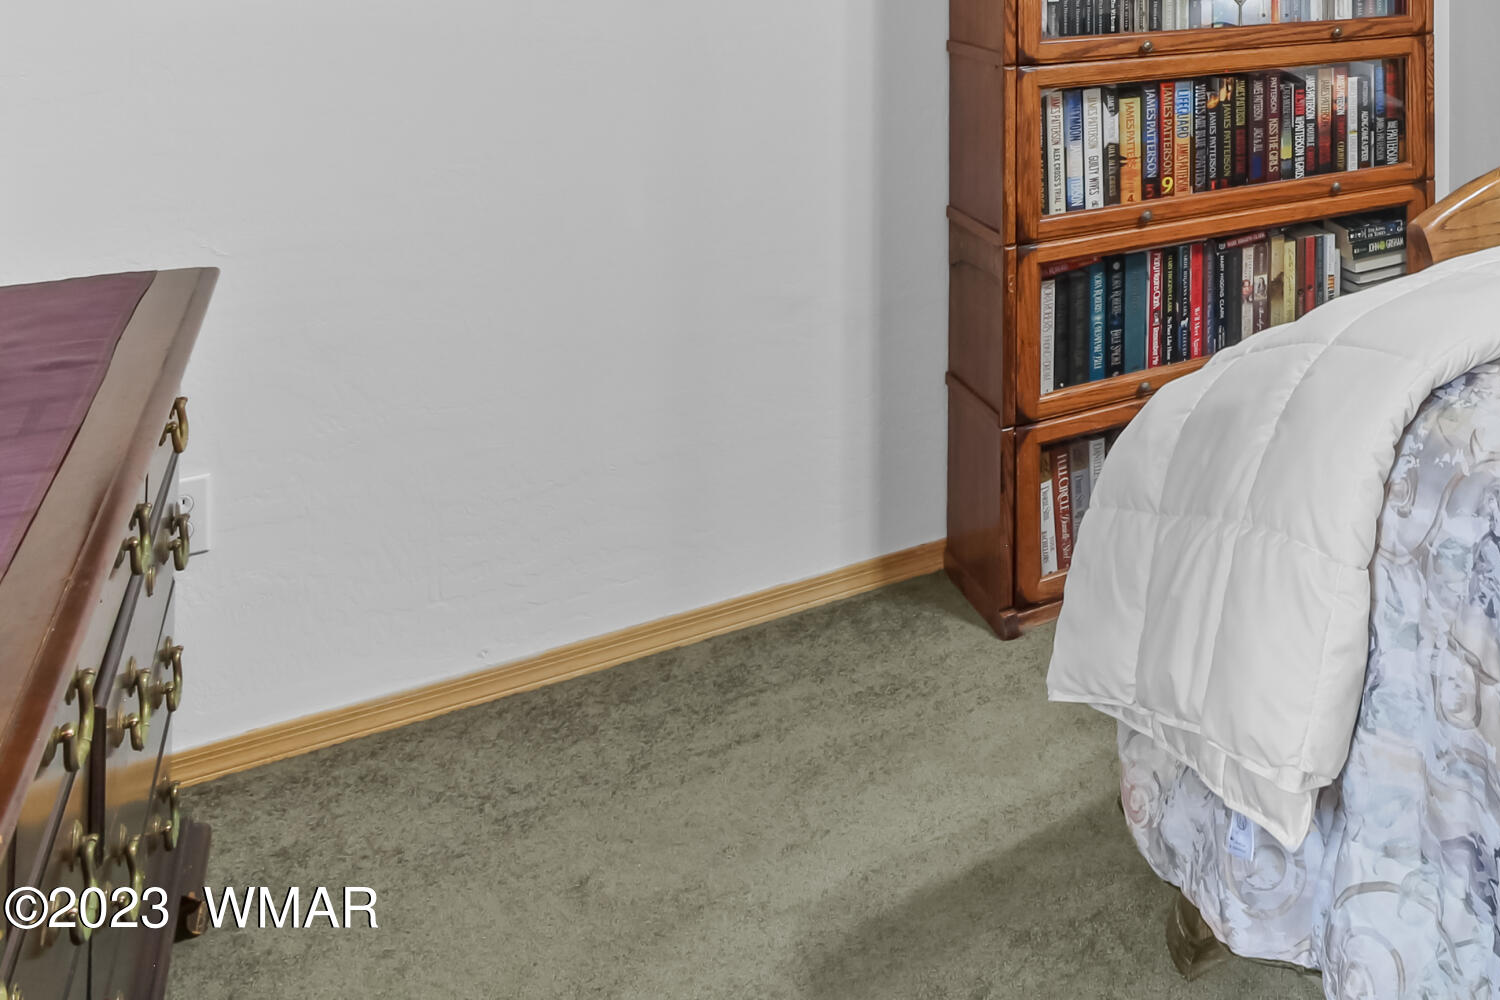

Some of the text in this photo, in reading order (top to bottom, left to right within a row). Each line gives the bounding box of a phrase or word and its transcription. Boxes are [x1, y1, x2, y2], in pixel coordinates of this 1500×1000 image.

[1125, 102, 1135, 130] JAMES
[1177, 89, 1189, 138] LIFEGUARD
[1269, 118, 1279, 134] KISS
[1145, 89, 1157, 178] JAMES PATTERSON
[1162, 87, 1173, 175] JAMES PATTERSON
[1222, 104, 1231, 176] JAMES PATTERSON
[1269, 135, 1278, 150] THE
[1269, 151, 1278, 172] GIRLS
[1295, 162, 1304, 179] GROS
[1058, 477, 1070, 512] CIRCLE
